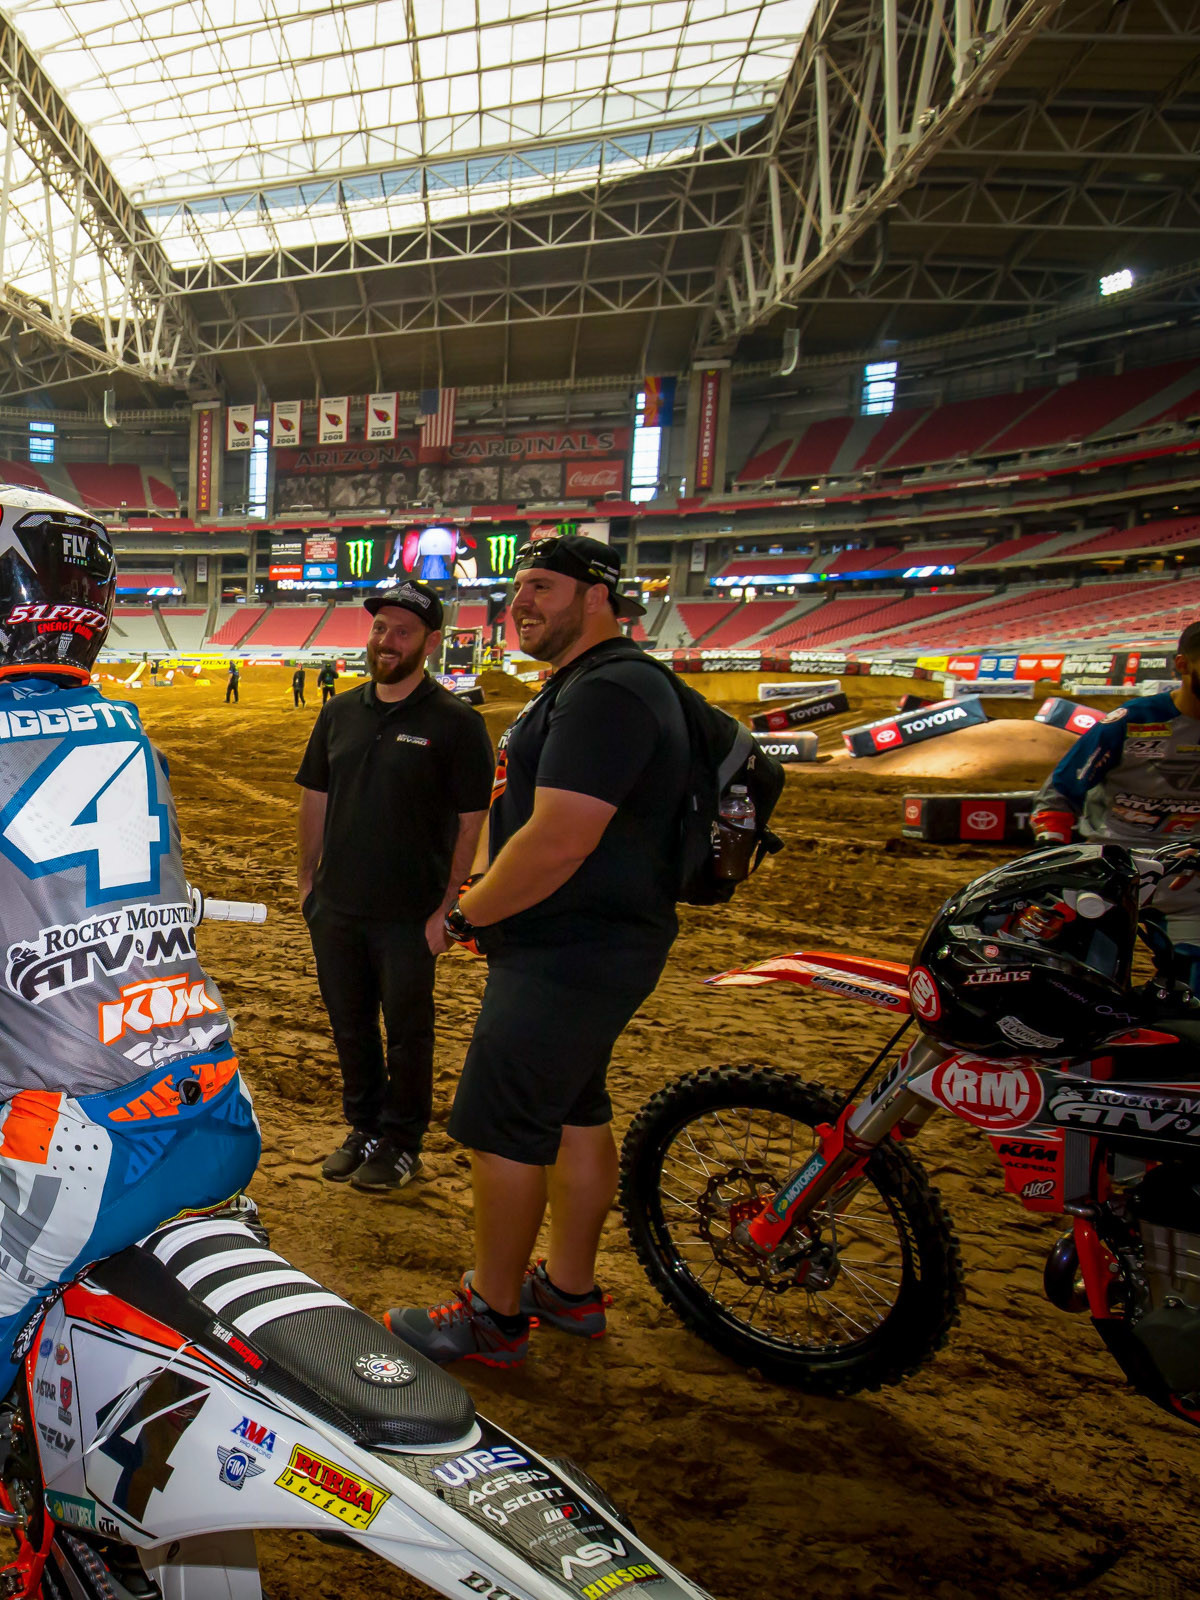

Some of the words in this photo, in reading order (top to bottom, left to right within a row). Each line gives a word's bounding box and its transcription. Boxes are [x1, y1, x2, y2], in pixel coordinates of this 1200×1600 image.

[702, 382, 714, 457] ESTABLISHED
[295, 446, 416, 468] ARIZONA
[447, 433, 615, 459] CARDINALS
[568, 469, 618, 488] Coca-Cola
[63, 533, 89, 557] FLY
[64, 557, 88, 566] RACING
[38, 621, 74, 634] ENERGY
[1140, 658, 1167, 668] TOYOTA
[790, 702, 835, 720] TOYOTA
[902, 706, 968, 735] TOYOTA
[3, 741, 161, 889] 4
[44, 916, 122, 956] ROCKY
[811, 975, 901, 1005] Palmetto
[963, 971, 1031, 986] 51FIFTY
[100, 975, 220, 1045] KTM
[1000, 1018, 1057, 1048] CHEROKEE
[1089, 1088, 1170, 1111] ROCKY
[999, 1141, 1058, 1162] KTM
[785, 1159, 823, 1202] MOTOREX
[1022, 1180, 1054, 1199] HBD
[887, 1194, 922, 1282] DUNLOP
[356, 1353, 388, 1369] SEAT
[363, 1359, 412, 1383] CONCEPTS
[231, 1415, 278, 1453] AMA
[239, 1438, 251, 1449] PRO
[251, 1445, 273, 1460] RACING
[226, 1458, 245, 1477] FIM
[434, 1446, 529, 1487] WPS
[286, 1474, 362, 1521] burger
[502, 1487, 565, 1515] SCOTT
[61, 1500, 94, 1529] MOTOREX
[542, 1505, 574, 1525] WP
[528, 1524, 575, 1549] RACING
[548, 1524, 606, 1547] SYSTEMS
[560, 1538, 628, 1581] ASV
[581, 1562, 659, 1600] HINSON
